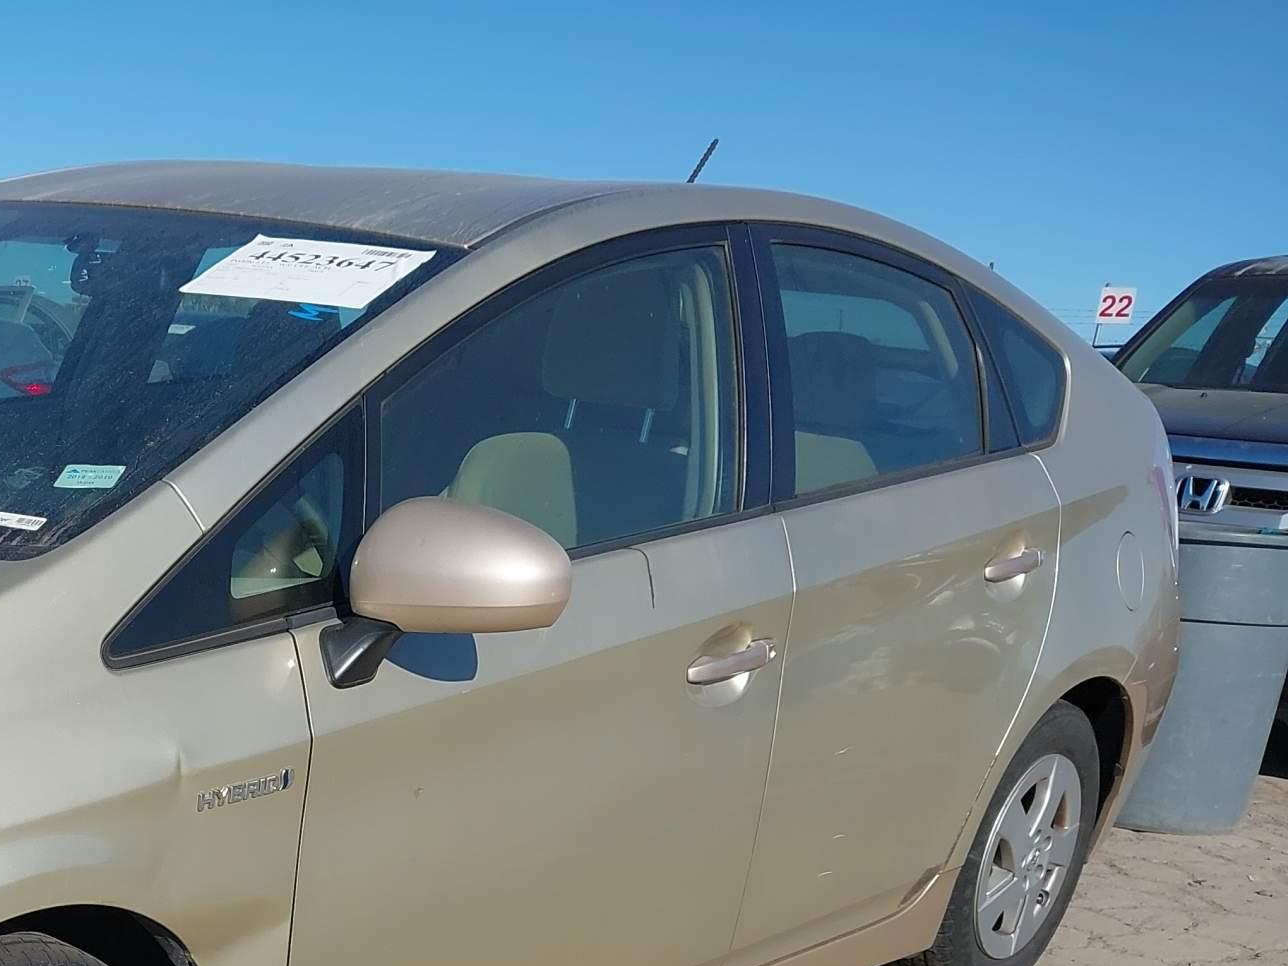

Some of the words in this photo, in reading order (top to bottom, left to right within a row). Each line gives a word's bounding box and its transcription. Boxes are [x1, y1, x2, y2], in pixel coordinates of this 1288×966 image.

[248, 249, 398, 272] 44523647
[1099, 295, 1133, 318] 22
[196, 774, 279, 813] HYBRID
